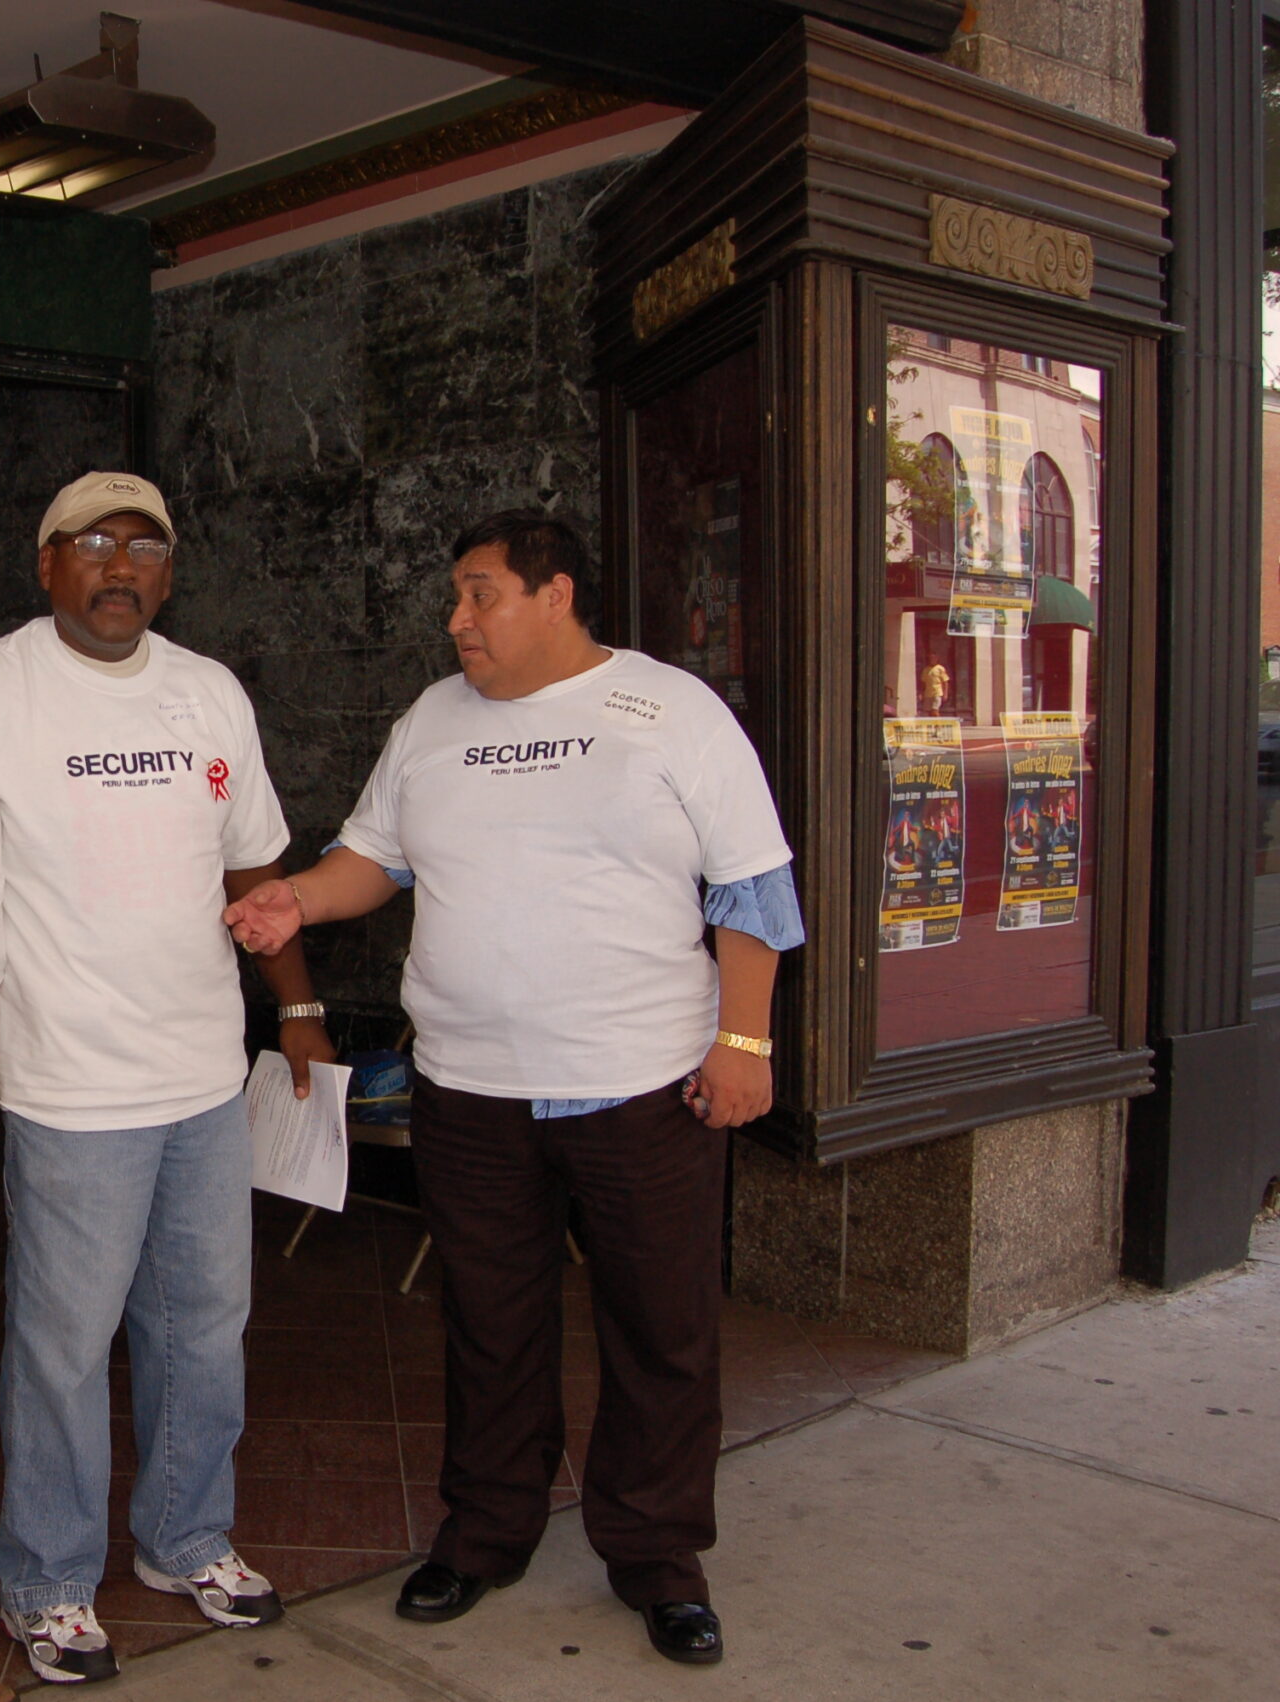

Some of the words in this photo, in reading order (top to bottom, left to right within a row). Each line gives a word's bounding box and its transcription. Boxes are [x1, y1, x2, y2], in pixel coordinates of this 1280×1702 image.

[611, 690, 662, 711] ROBERTO
[463, 736, 596, 766] SECURITY
[66, 751, 194, 778] SECURITY
[490, 768, 511, 776] PERU
[513, 765, 538, 774] RELIEF
[541, 763, 561, 772] FUND
[102, 780, 122, 788] PERU
[124, 778, 149, 787] RELIEF
[152, 777, 172, 786] FUND
